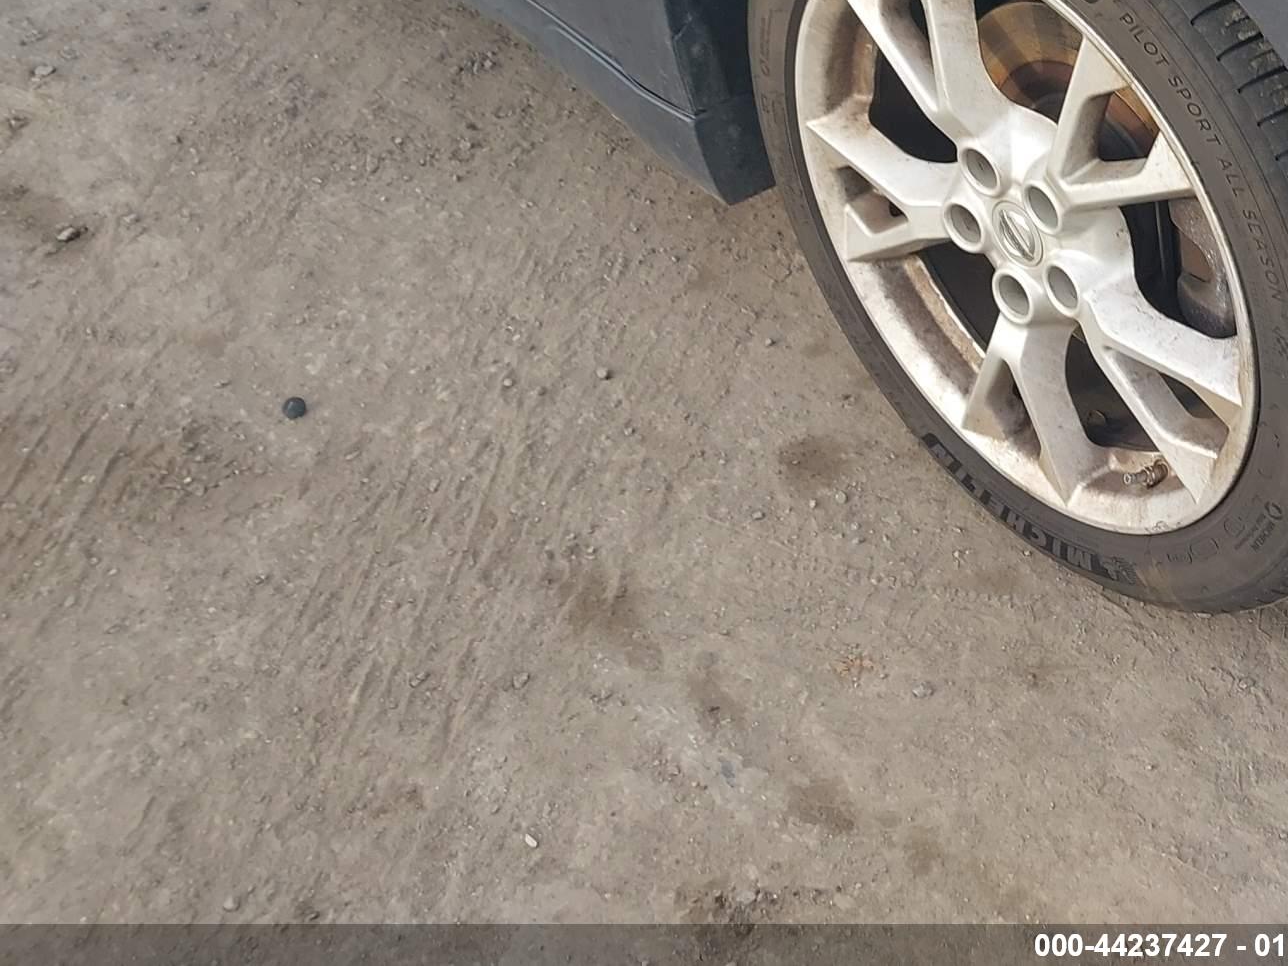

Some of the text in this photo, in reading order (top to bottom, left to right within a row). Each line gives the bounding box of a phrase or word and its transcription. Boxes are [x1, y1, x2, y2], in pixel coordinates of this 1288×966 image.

[1119, 12, 1286, 302] PILOT SPORT ALL SEASON
